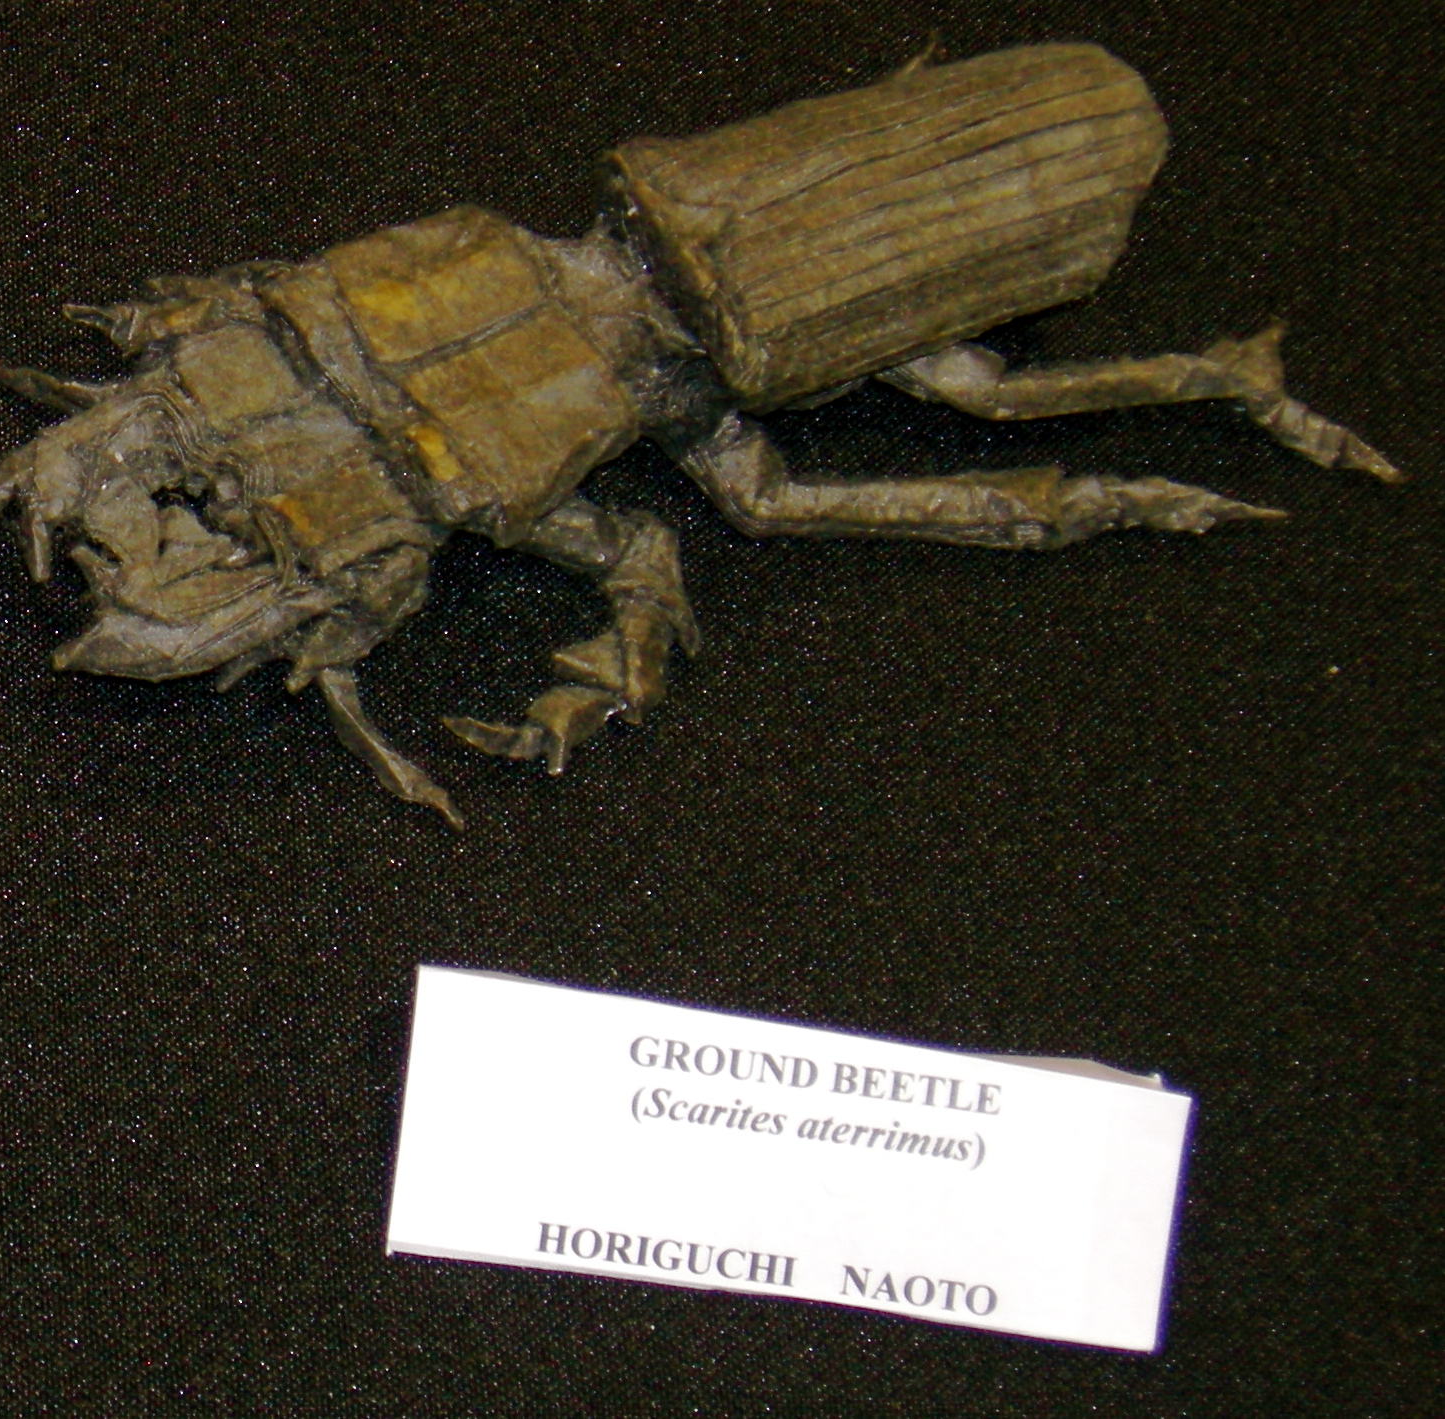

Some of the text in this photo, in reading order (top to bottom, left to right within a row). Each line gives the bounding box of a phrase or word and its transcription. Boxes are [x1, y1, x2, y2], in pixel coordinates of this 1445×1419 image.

[629, 1035, 1002, 1115] GROUND BEETLE
[631, 1087, 987, 1170] (Scarites aterrimus)
[536, 1221, 998, 1316] HORIGUCHI NAOTO
